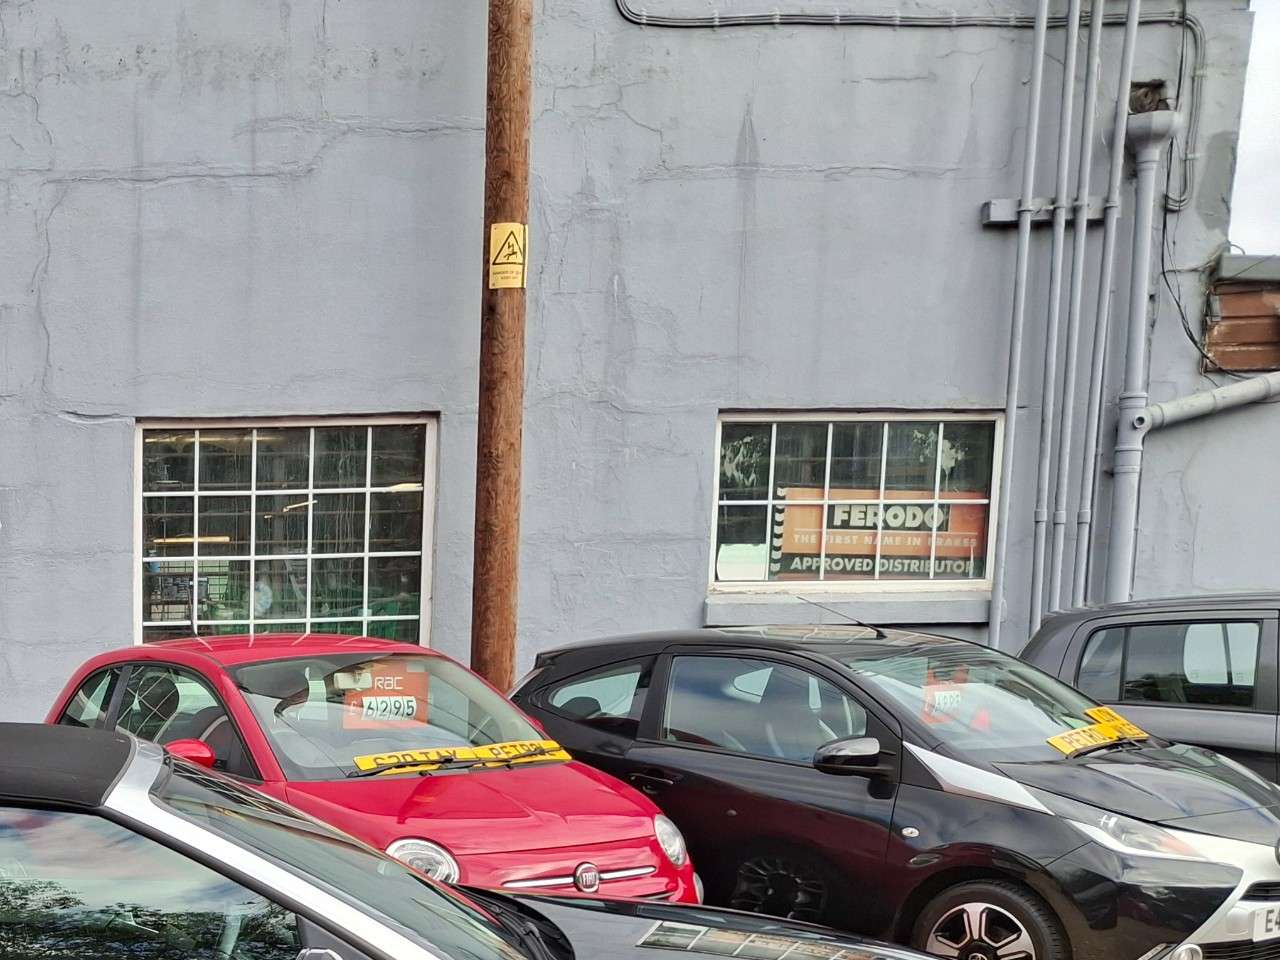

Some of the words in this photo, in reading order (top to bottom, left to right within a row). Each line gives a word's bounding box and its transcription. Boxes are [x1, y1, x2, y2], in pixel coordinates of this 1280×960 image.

[832, 503, 945, 529] FERODO
[792, 533, 817, 546] THE
[906, 536, 921, 547] IN
[790, 556, 874, 572] APPROVED
[879, 557, 975, 574] DISTRIBUTOR
